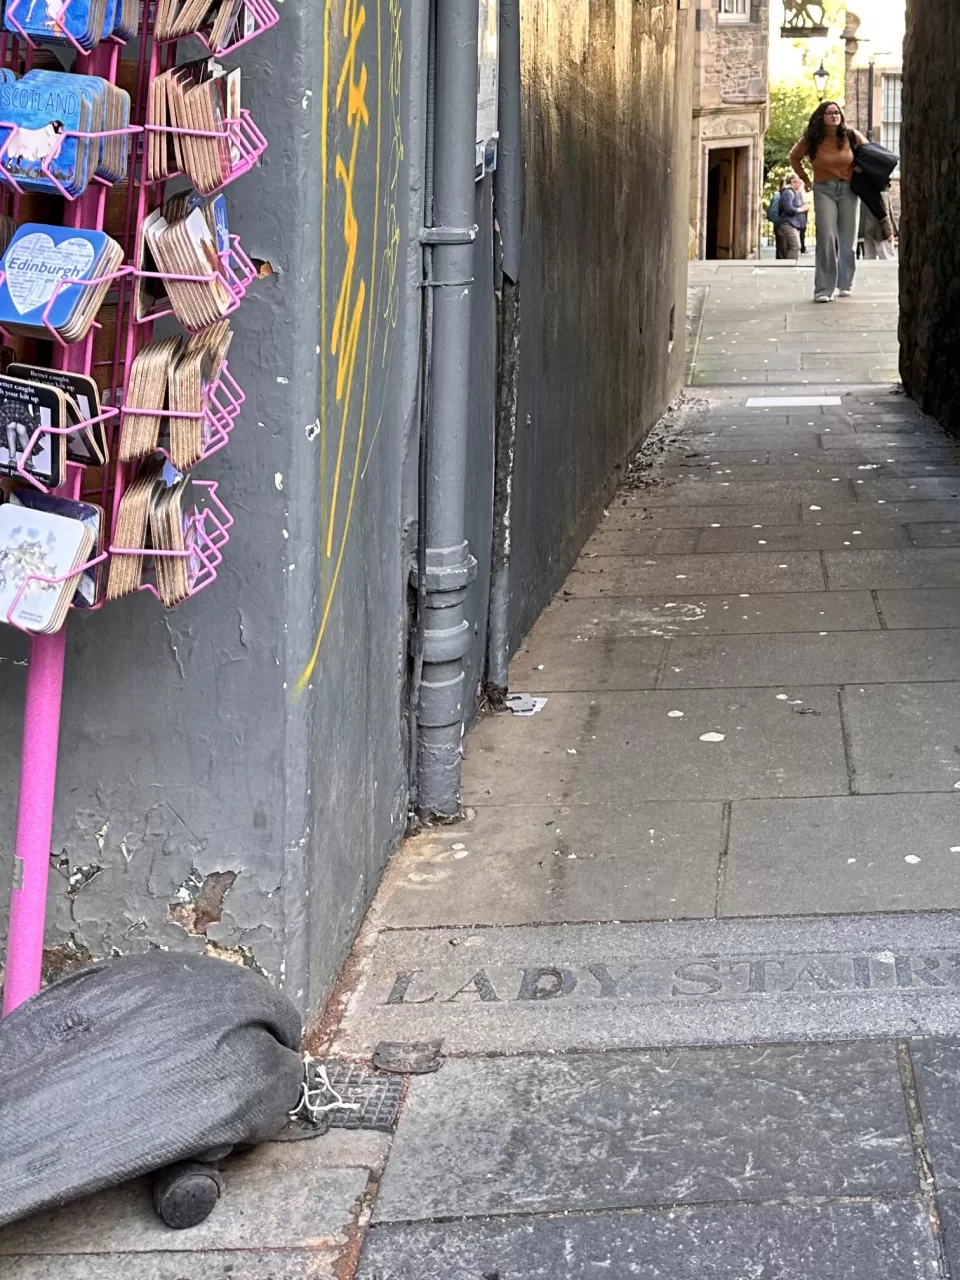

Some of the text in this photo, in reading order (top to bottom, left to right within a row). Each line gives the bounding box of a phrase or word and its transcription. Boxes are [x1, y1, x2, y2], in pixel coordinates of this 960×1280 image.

[3, 84, 76, 115] SCOTLAND
[8, 257, 81, 280] Edinburgh
[14, 385, 35, 394] caught
[19, 392, 30, 400] kilt
[30, 396, 39, 404] up
[378, 963, 638, 1005] LADY
